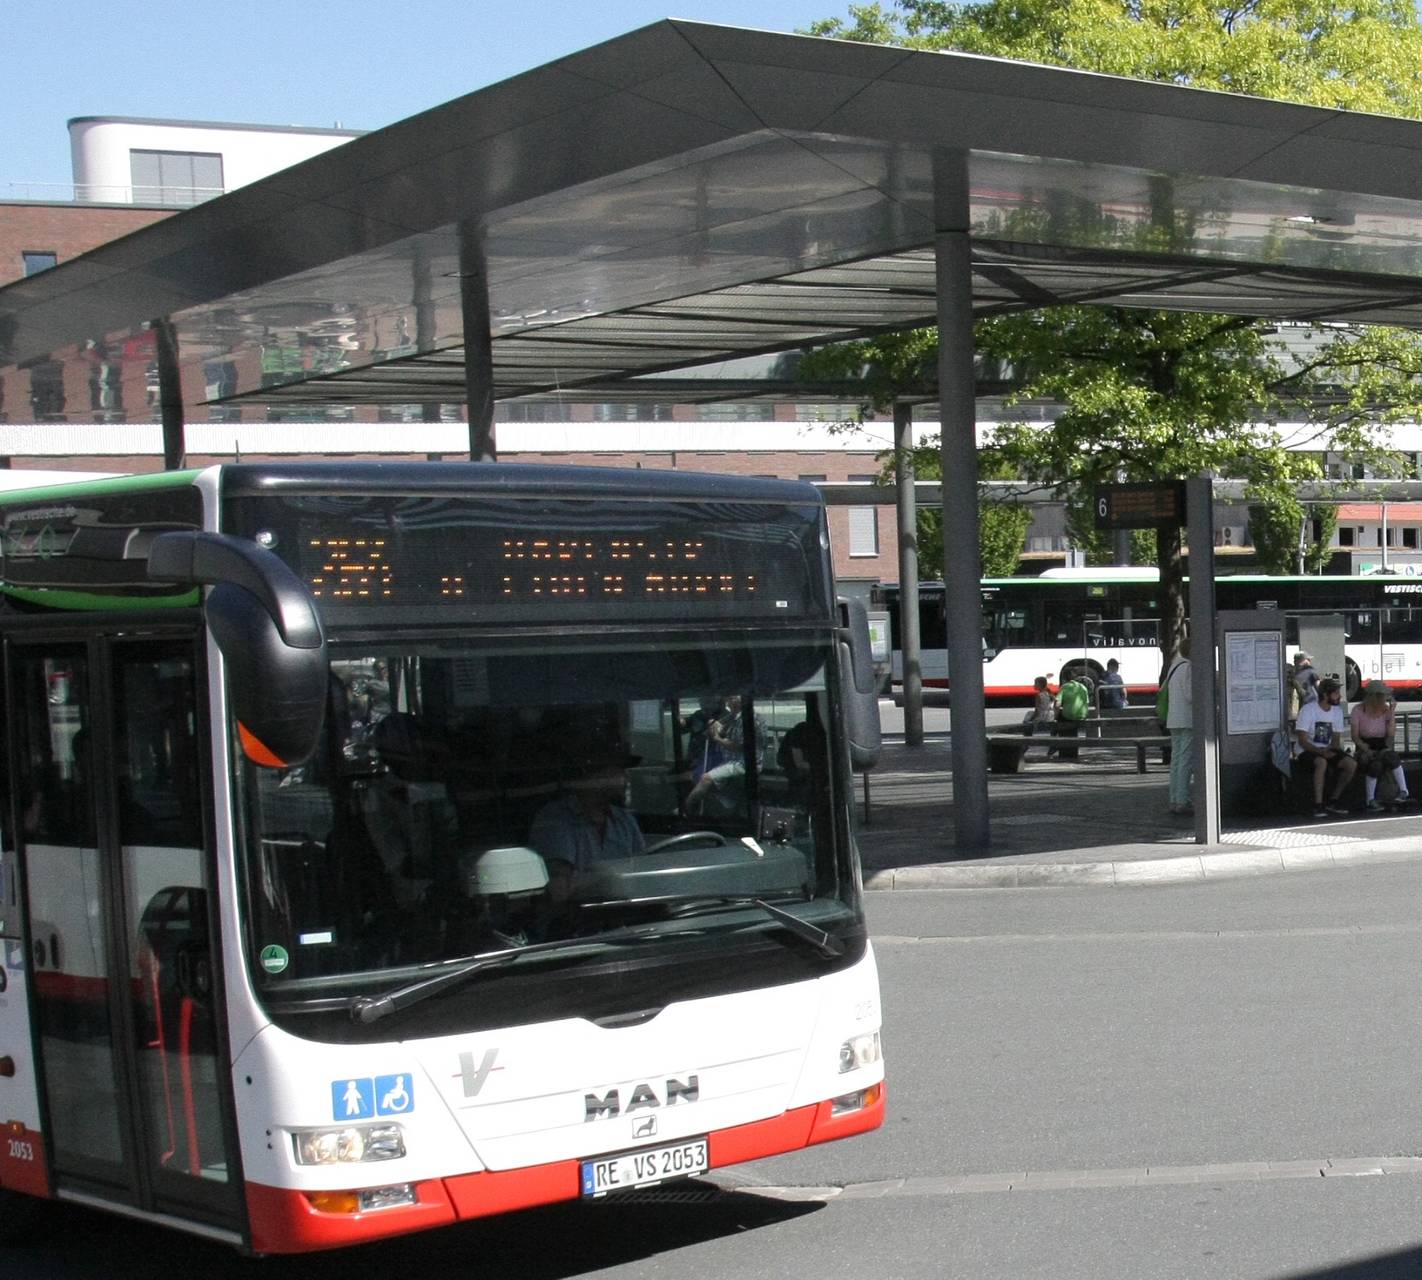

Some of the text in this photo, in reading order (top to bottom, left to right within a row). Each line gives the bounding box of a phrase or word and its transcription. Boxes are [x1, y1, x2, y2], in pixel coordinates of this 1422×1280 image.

[1099, 498, 1107, 517] 6
[584, 1075, 699, 1122] MAN
[8, 1139, 34, 1161] 2053
[596, 1144, 705, 1188] RE VS 2053
